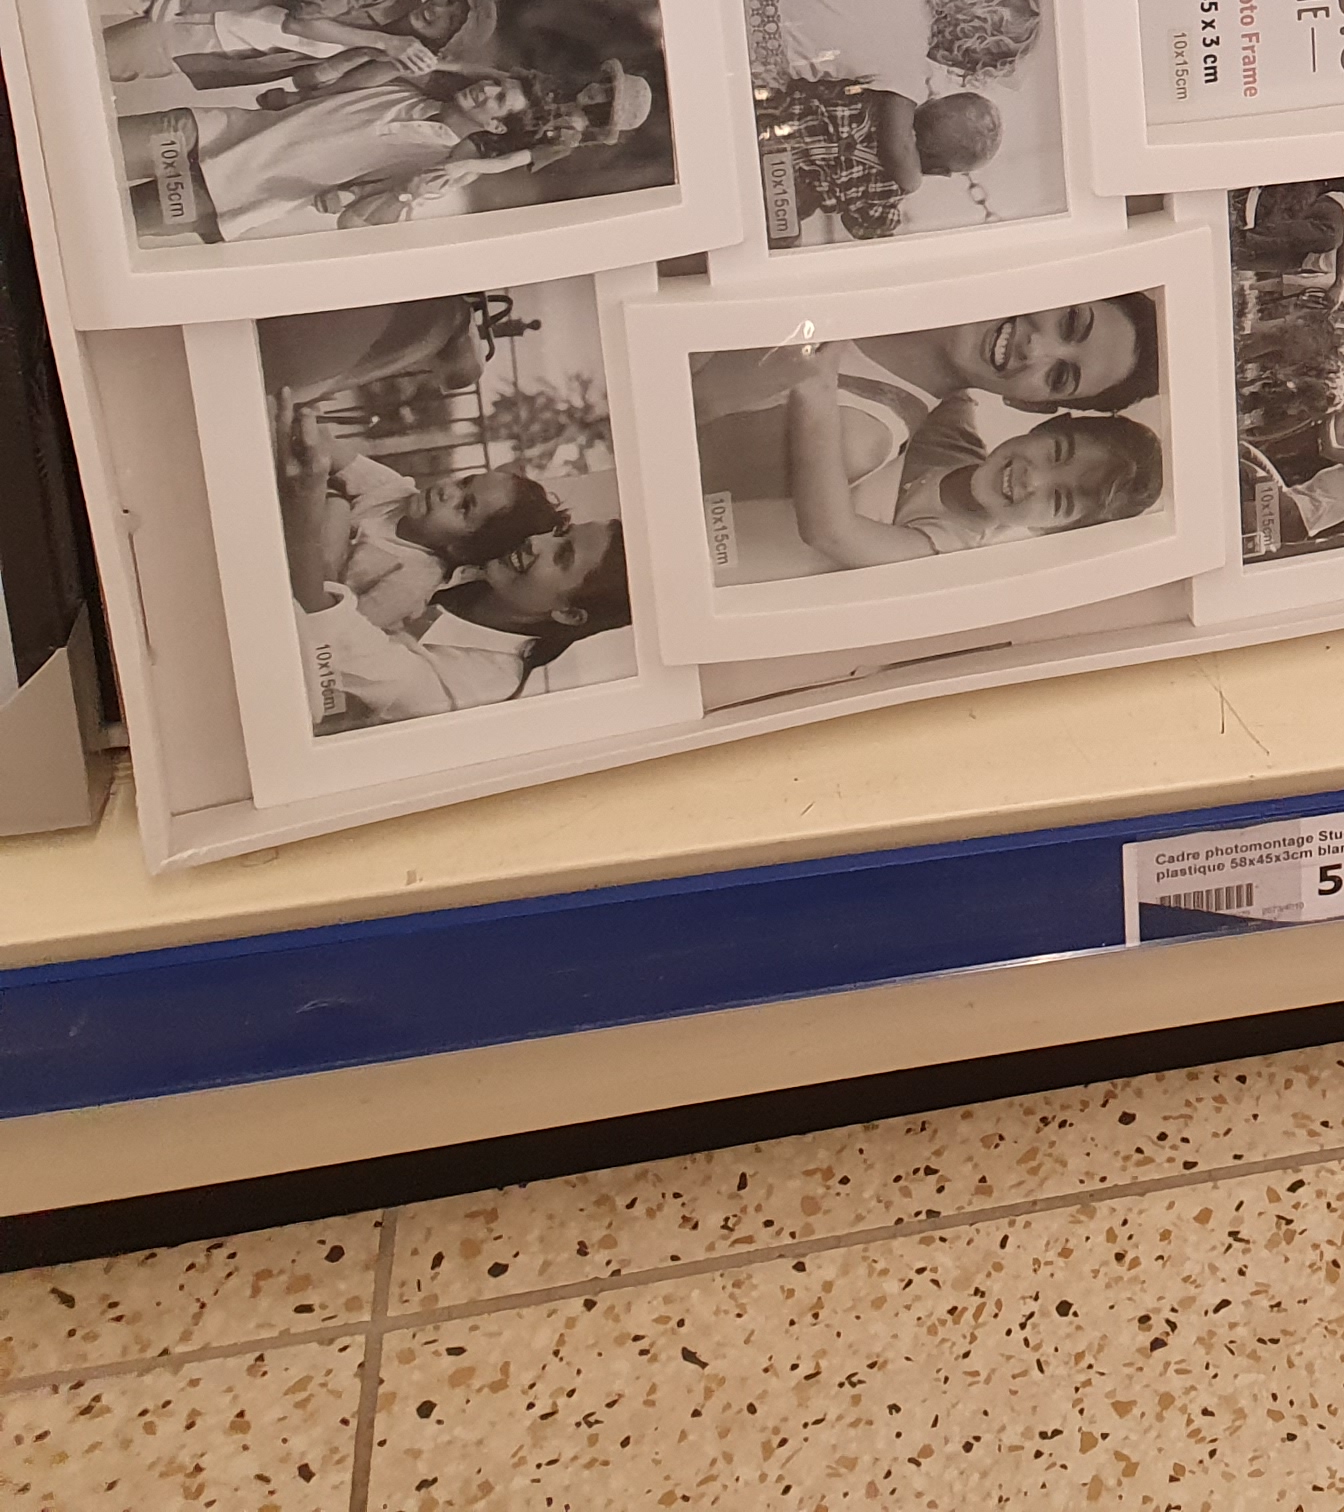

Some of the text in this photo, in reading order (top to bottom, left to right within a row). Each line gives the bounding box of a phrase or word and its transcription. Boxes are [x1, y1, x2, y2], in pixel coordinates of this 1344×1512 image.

[1201, 35, 1220, 48] 3
[1202, 18, 1216, 31] x
[1172, 31, 1189, 101] 10x15cm
[1203, 54, 1219, 85] cm
[1241, 32, 1260, 99] Frame
[159, 139, 185, 219] 10x15cm
[770, 160, 788, 233] 10x15cm
[711, 497, 729, 565] 10x15cm
[1260, 487, 1274, 550] 10x15cm
[315, 643, 337, 712] 10x15cm
[1155, 850, 1201, 866] Cadre
[1205, 834, 1314, 861] photomontage
[1156, 861, 1226, 882] plastique
[1230, 848, 1314, 869] 58x45x3cm
